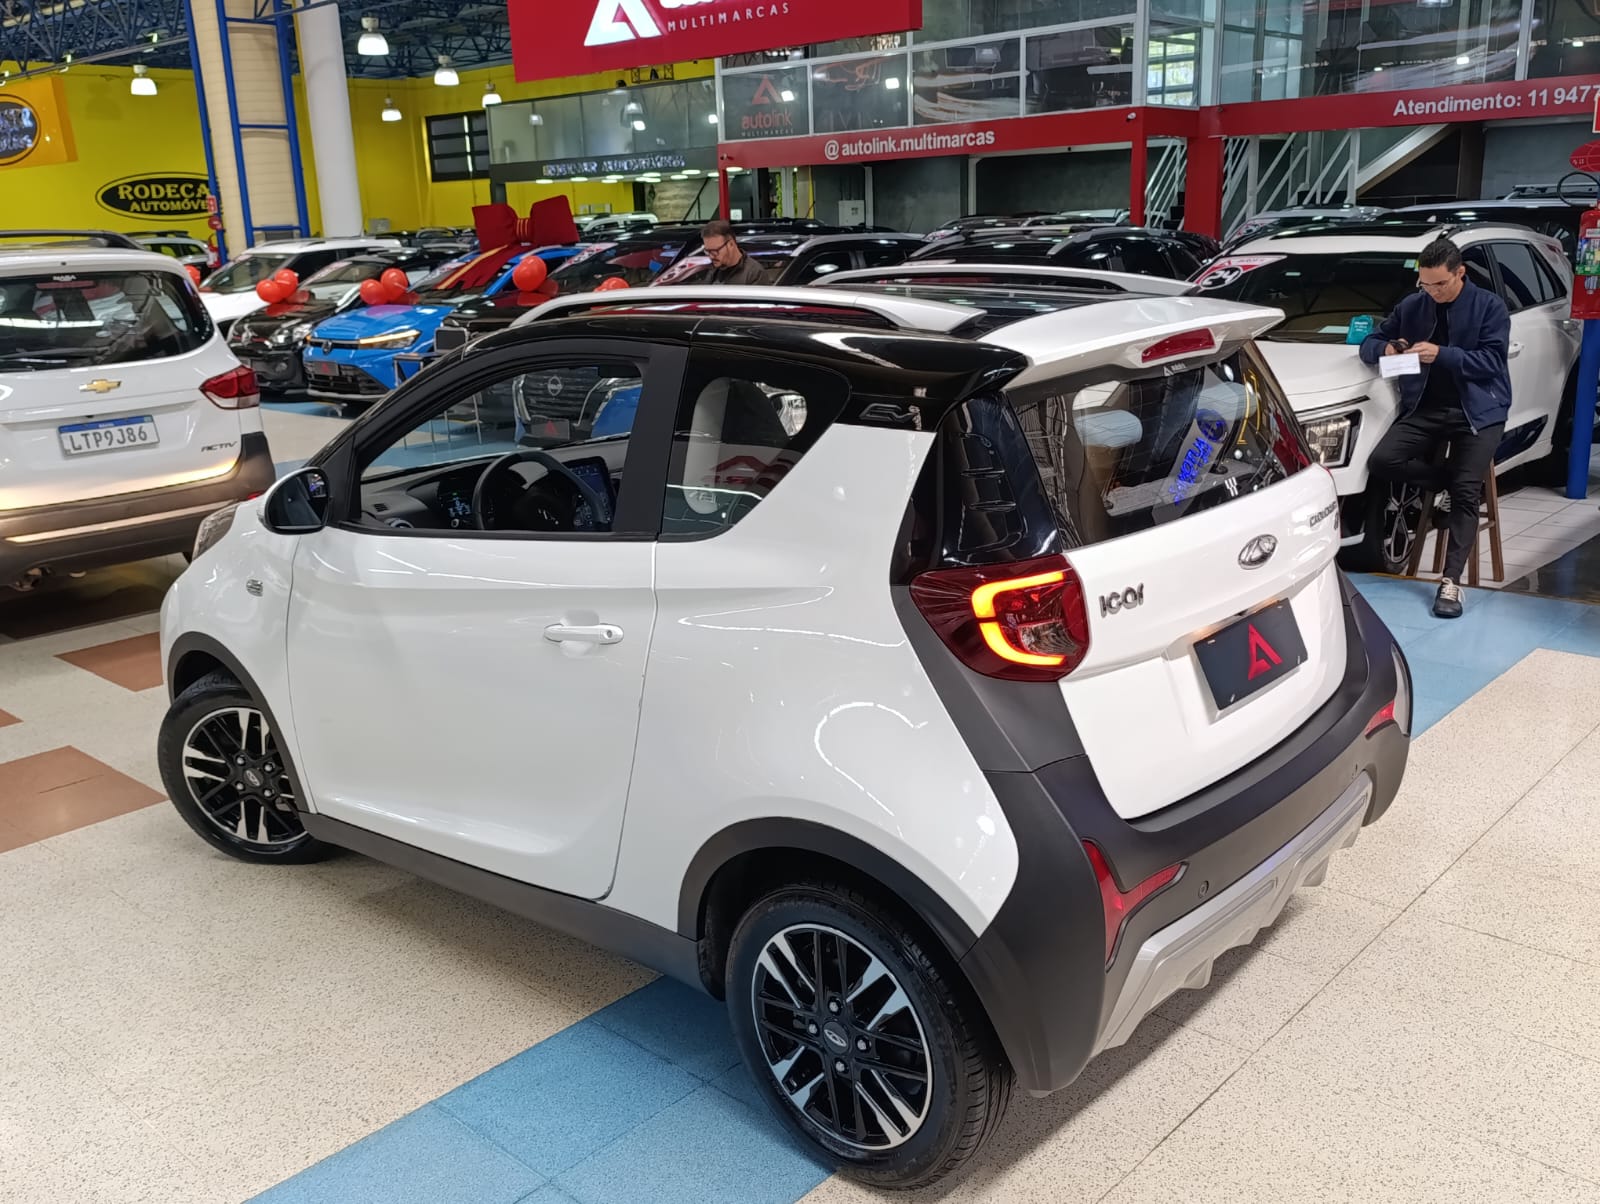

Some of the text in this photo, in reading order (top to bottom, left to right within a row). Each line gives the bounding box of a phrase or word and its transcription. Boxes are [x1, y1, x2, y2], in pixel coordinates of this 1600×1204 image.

[667, 3, 789, 32] MULTIMARCAS
[1393, 93, 1522, 116] Atendimento:
[1527, 88, 1548, 107] 11
[742, 107, 792, 129] autolink
[841, 131, 995, 156] autolink.multimarcas
[1202, 270, 1239, 286] 24
[69, 425, 148, 451] LTP9J86
[201, 441, 237, 452] ACTIV
